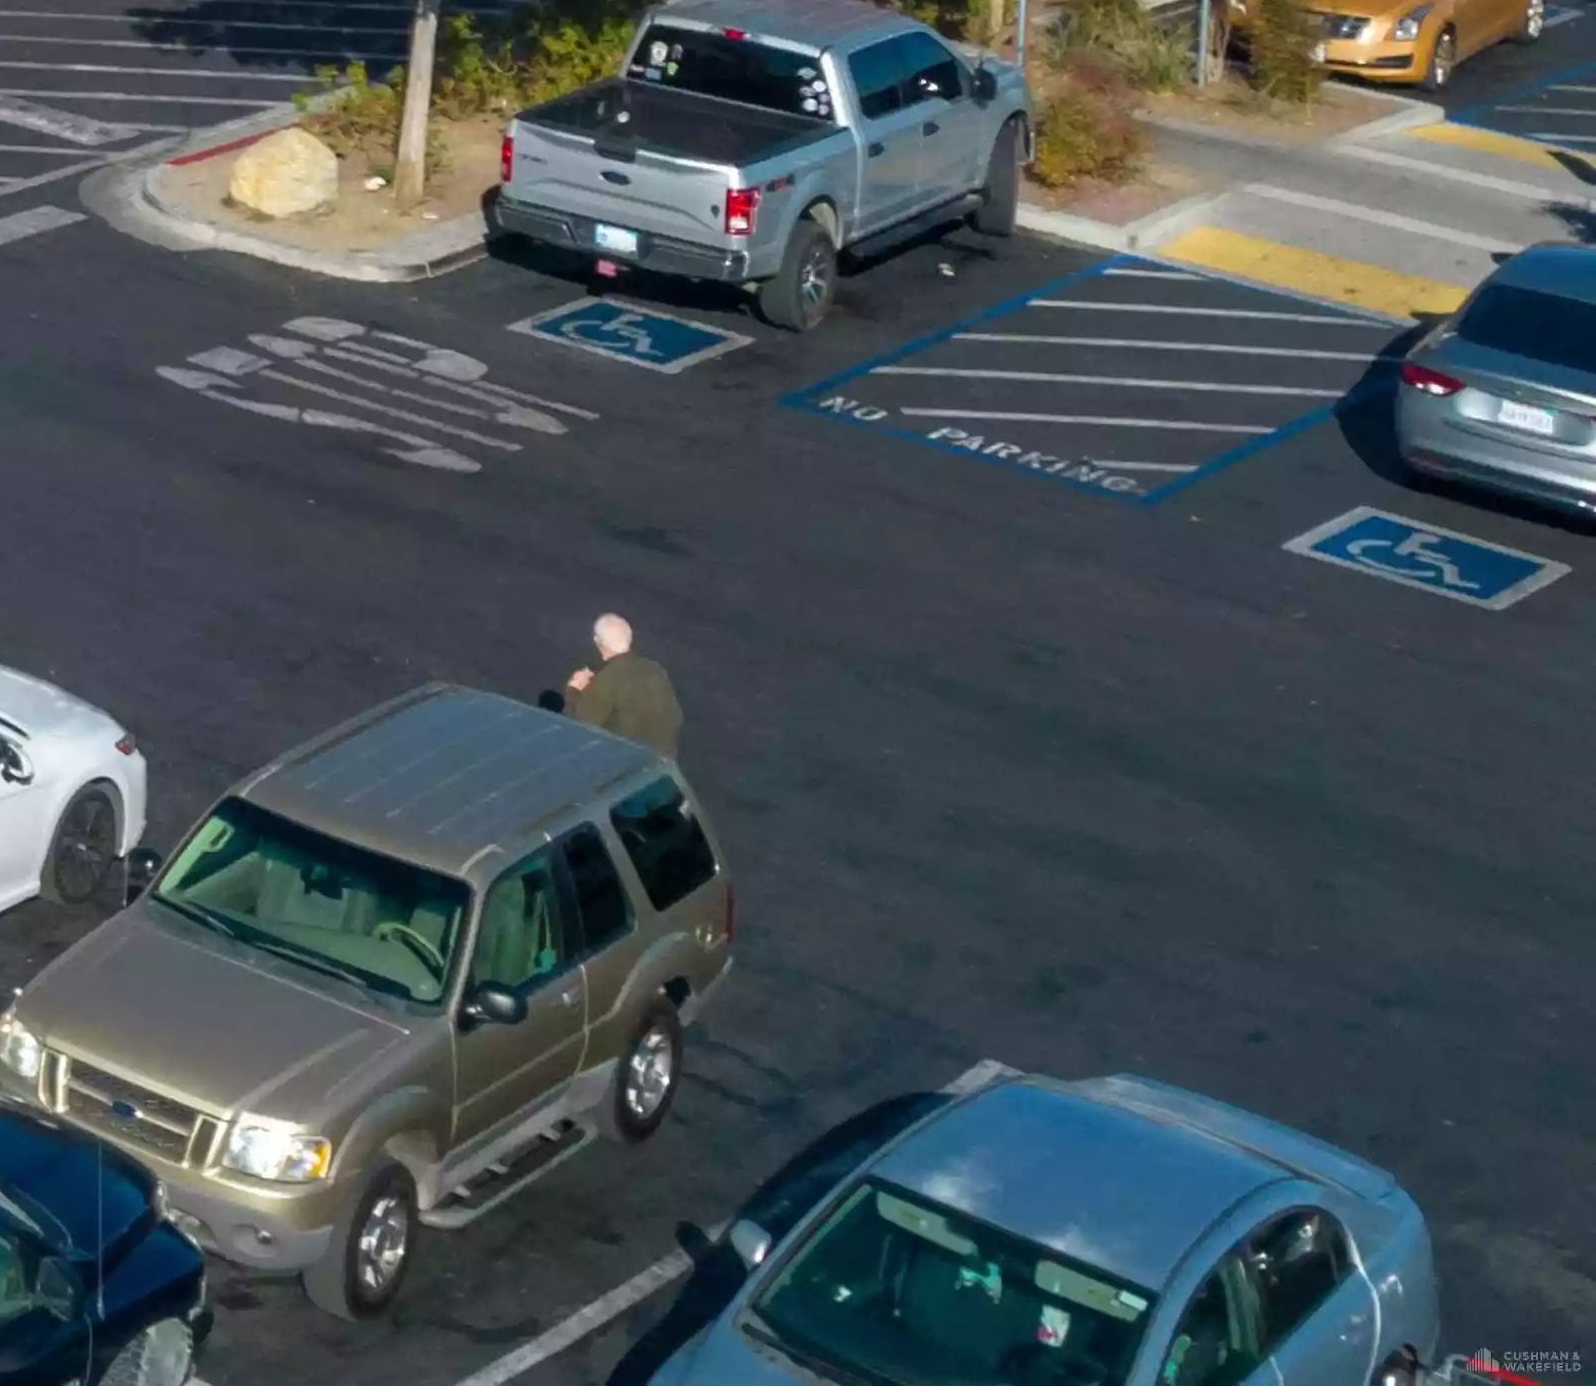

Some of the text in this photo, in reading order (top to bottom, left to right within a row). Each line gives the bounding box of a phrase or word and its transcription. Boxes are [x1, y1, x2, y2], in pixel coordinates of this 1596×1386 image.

[155, 315, 601, 474] STOP
[819, 395, 1139, 493] NO PARKING
